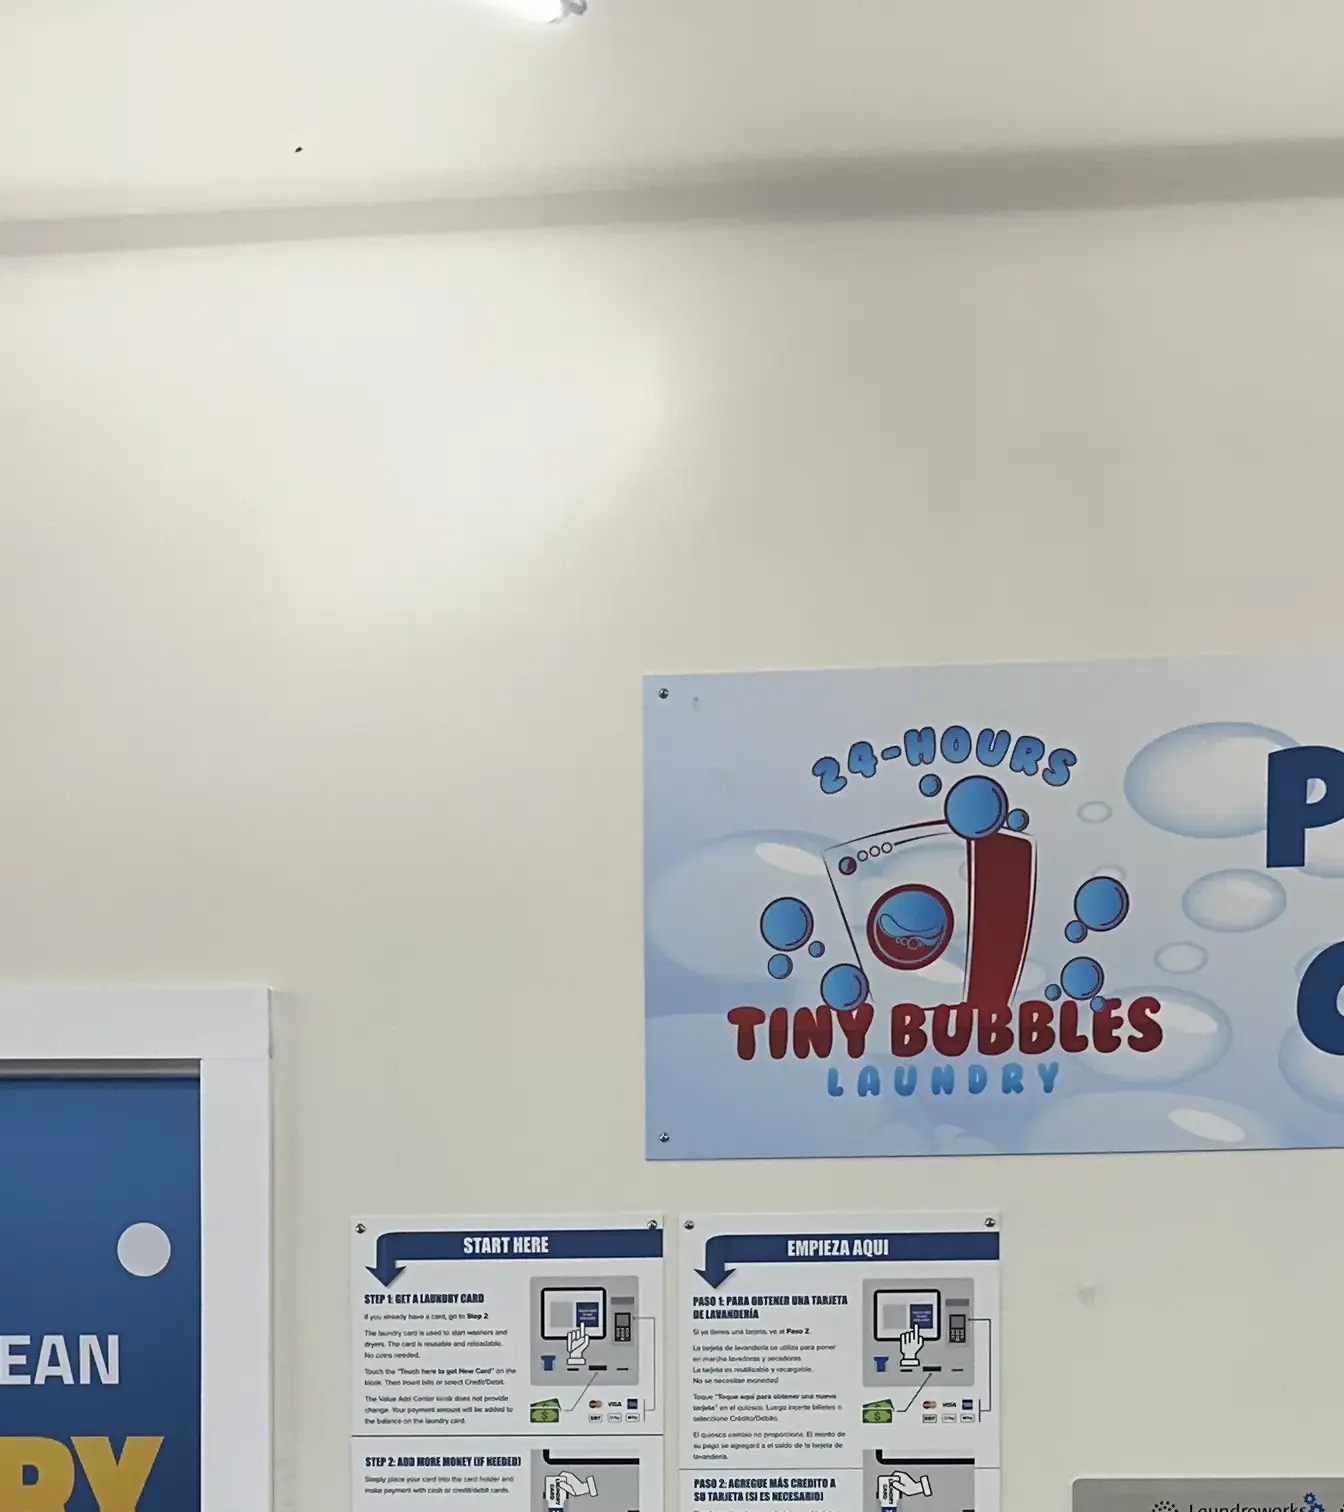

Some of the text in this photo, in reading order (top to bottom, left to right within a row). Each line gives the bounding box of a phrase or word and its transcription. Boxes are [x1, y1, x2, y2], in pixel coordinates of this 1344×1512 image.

[812, 725, 1077, 795] 24-HOURS
[727, 996, 1163, 1061] TINY BUBBLES
[826, 1062, 1060, 1097] LAUNDRY
[463, 1236, 548, 1253] START HERE
[787, 1239, 888, 1257] EMPIEZA AQUI
[364, 1294, 385, 1304] STEP
[394, 1293, 411, 1304] GET
[412, 1293, 418, 1303] A
[419, 1293, 458, 1303] LAUNDRY
[460, 1293, 484, 1303] CARD
[692, 1296, 716, 1306] PASO
[726, 1296, 749, 1306] PARA
[751, 1295, 790, 1305] OBTENER
[791, 1295, 810, 1305] UNA
[811, 1295, 848, 1305] TARJETA
[692, 1308, 759, 1319] DE LAVANDERÍA
[365, 1456, 386, 1466] STEP
[387, 1456, 396, 1467] 2:
[396, 1456, 415, 1466] ADD
[416, 1456, 441, 1466] MORE
[442, 1456, 472, 1466] MONEY
[486, 1456, 521, 1466] NEEDED)
[693, 1476, 836, 1488] PASO 2: AGREGUE MÁS CREDITO A
[693, 1491, 823, 1501] SU TARJETA (SI ES NECESARIO)
